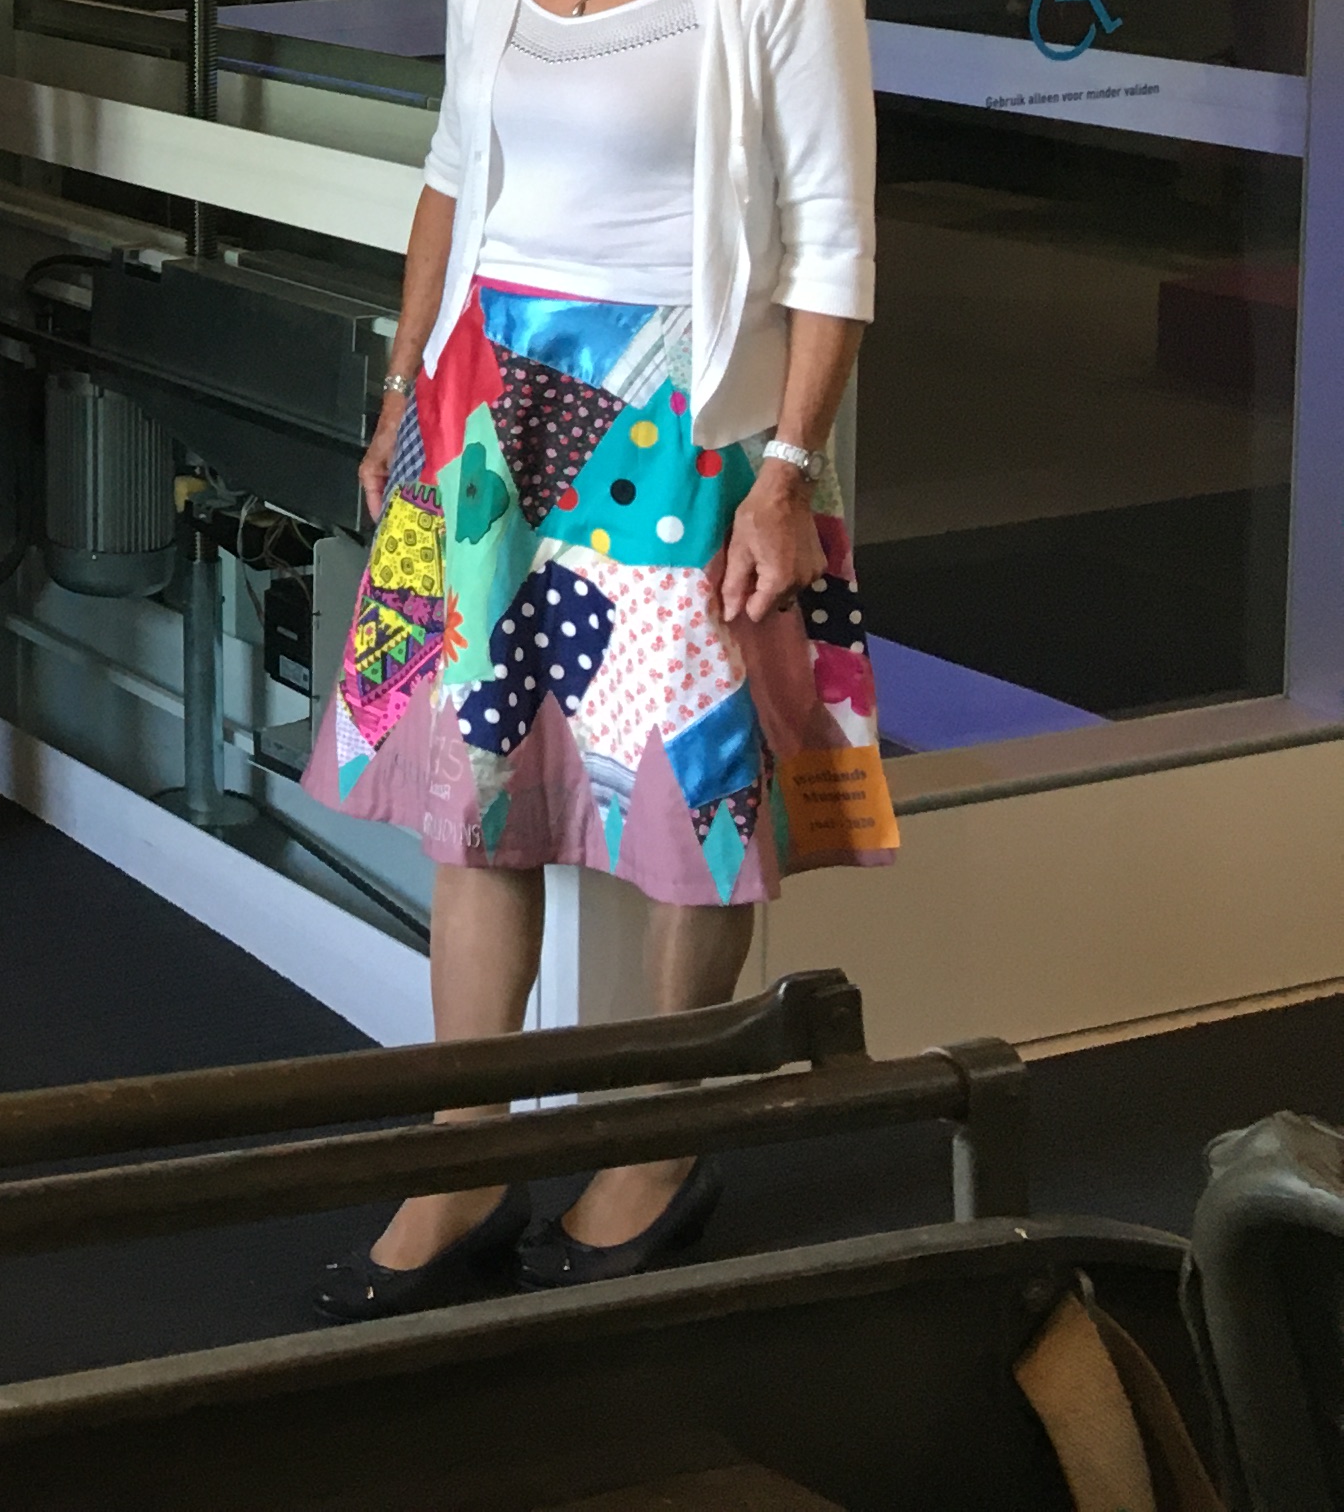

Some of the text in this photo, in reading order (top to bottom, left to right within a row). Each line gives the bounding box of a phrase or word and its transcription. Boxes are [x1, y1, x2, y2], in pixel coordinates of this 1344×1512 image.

[985, 83, 1160, 109] Gebruik alleen voor minder validen
